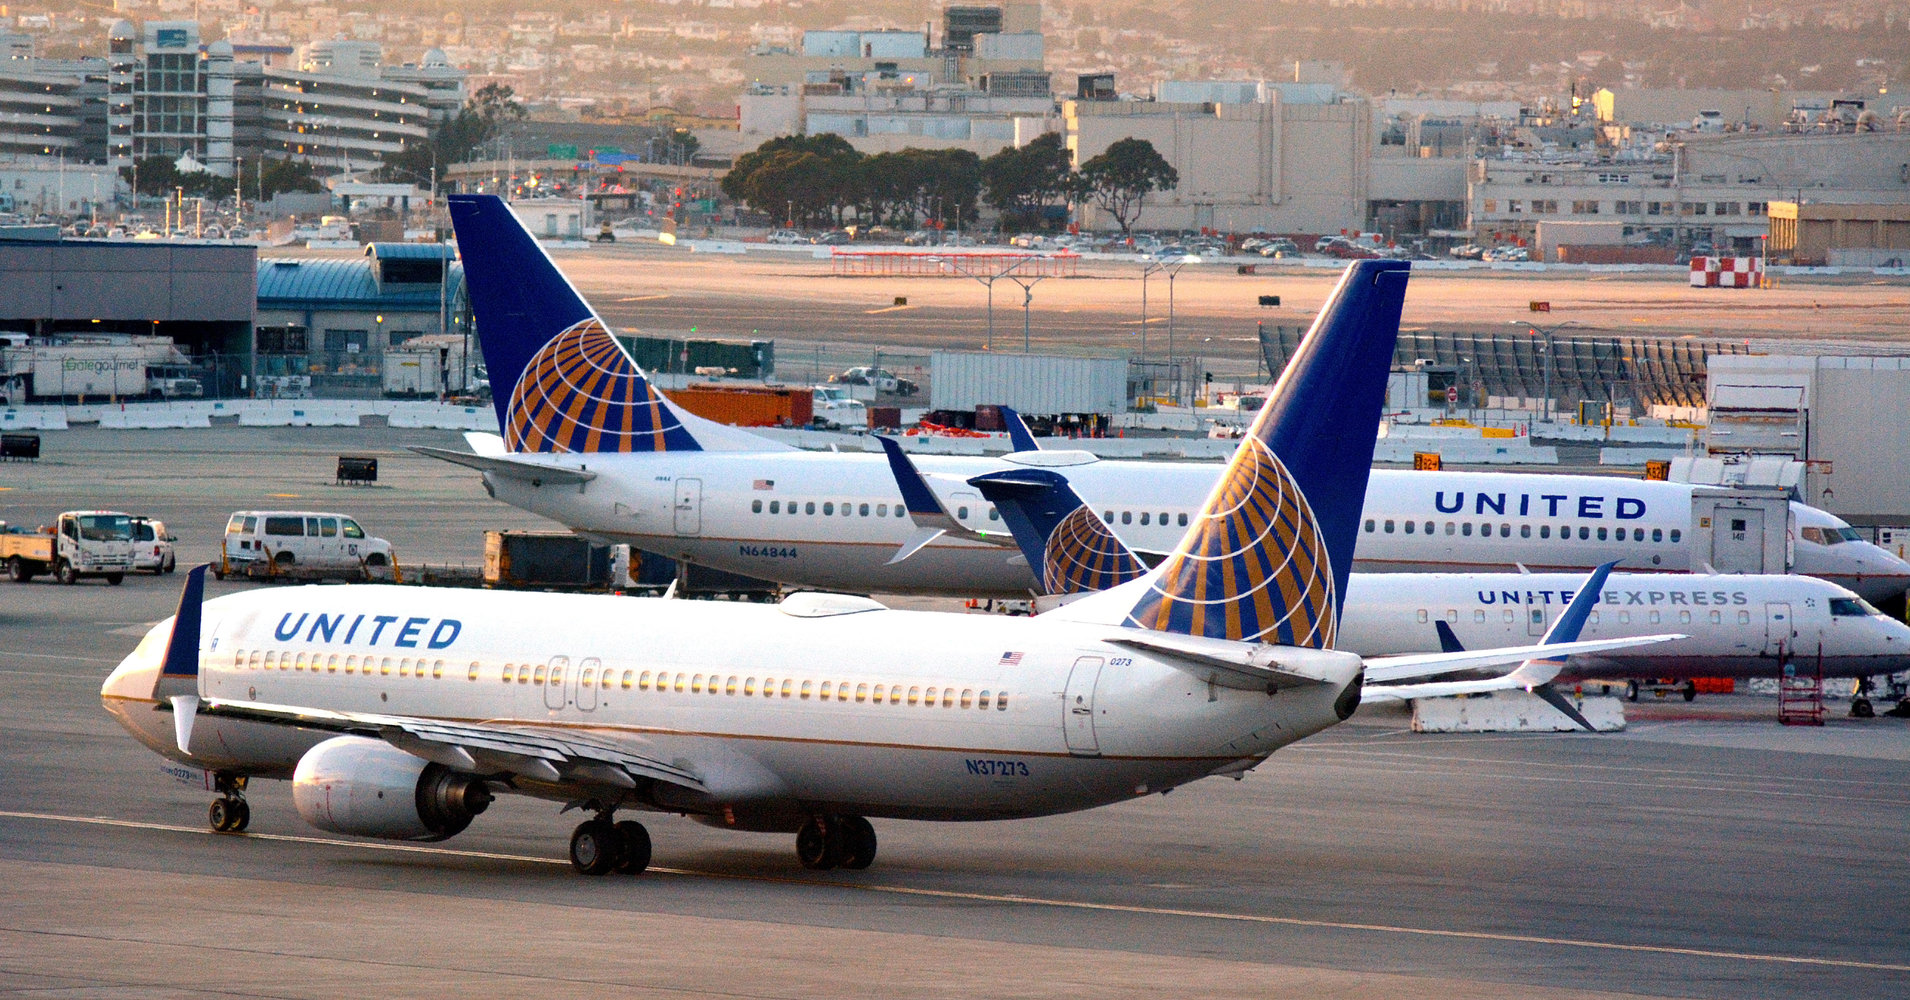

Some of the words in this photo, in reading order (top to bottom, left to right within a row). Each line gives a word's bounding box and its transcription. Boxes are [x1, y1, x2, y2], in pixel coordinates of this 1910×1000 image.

[1435, 491, 1646, 520] UNITED
[739, 545, 798, 558] N64844
[1478, 590, 1600, 605] UNITE
[274, 612, 462, 650] UNITED
[1110, 657, 1133, 667] 0273
[965, 759, 1030, 776] N37273
